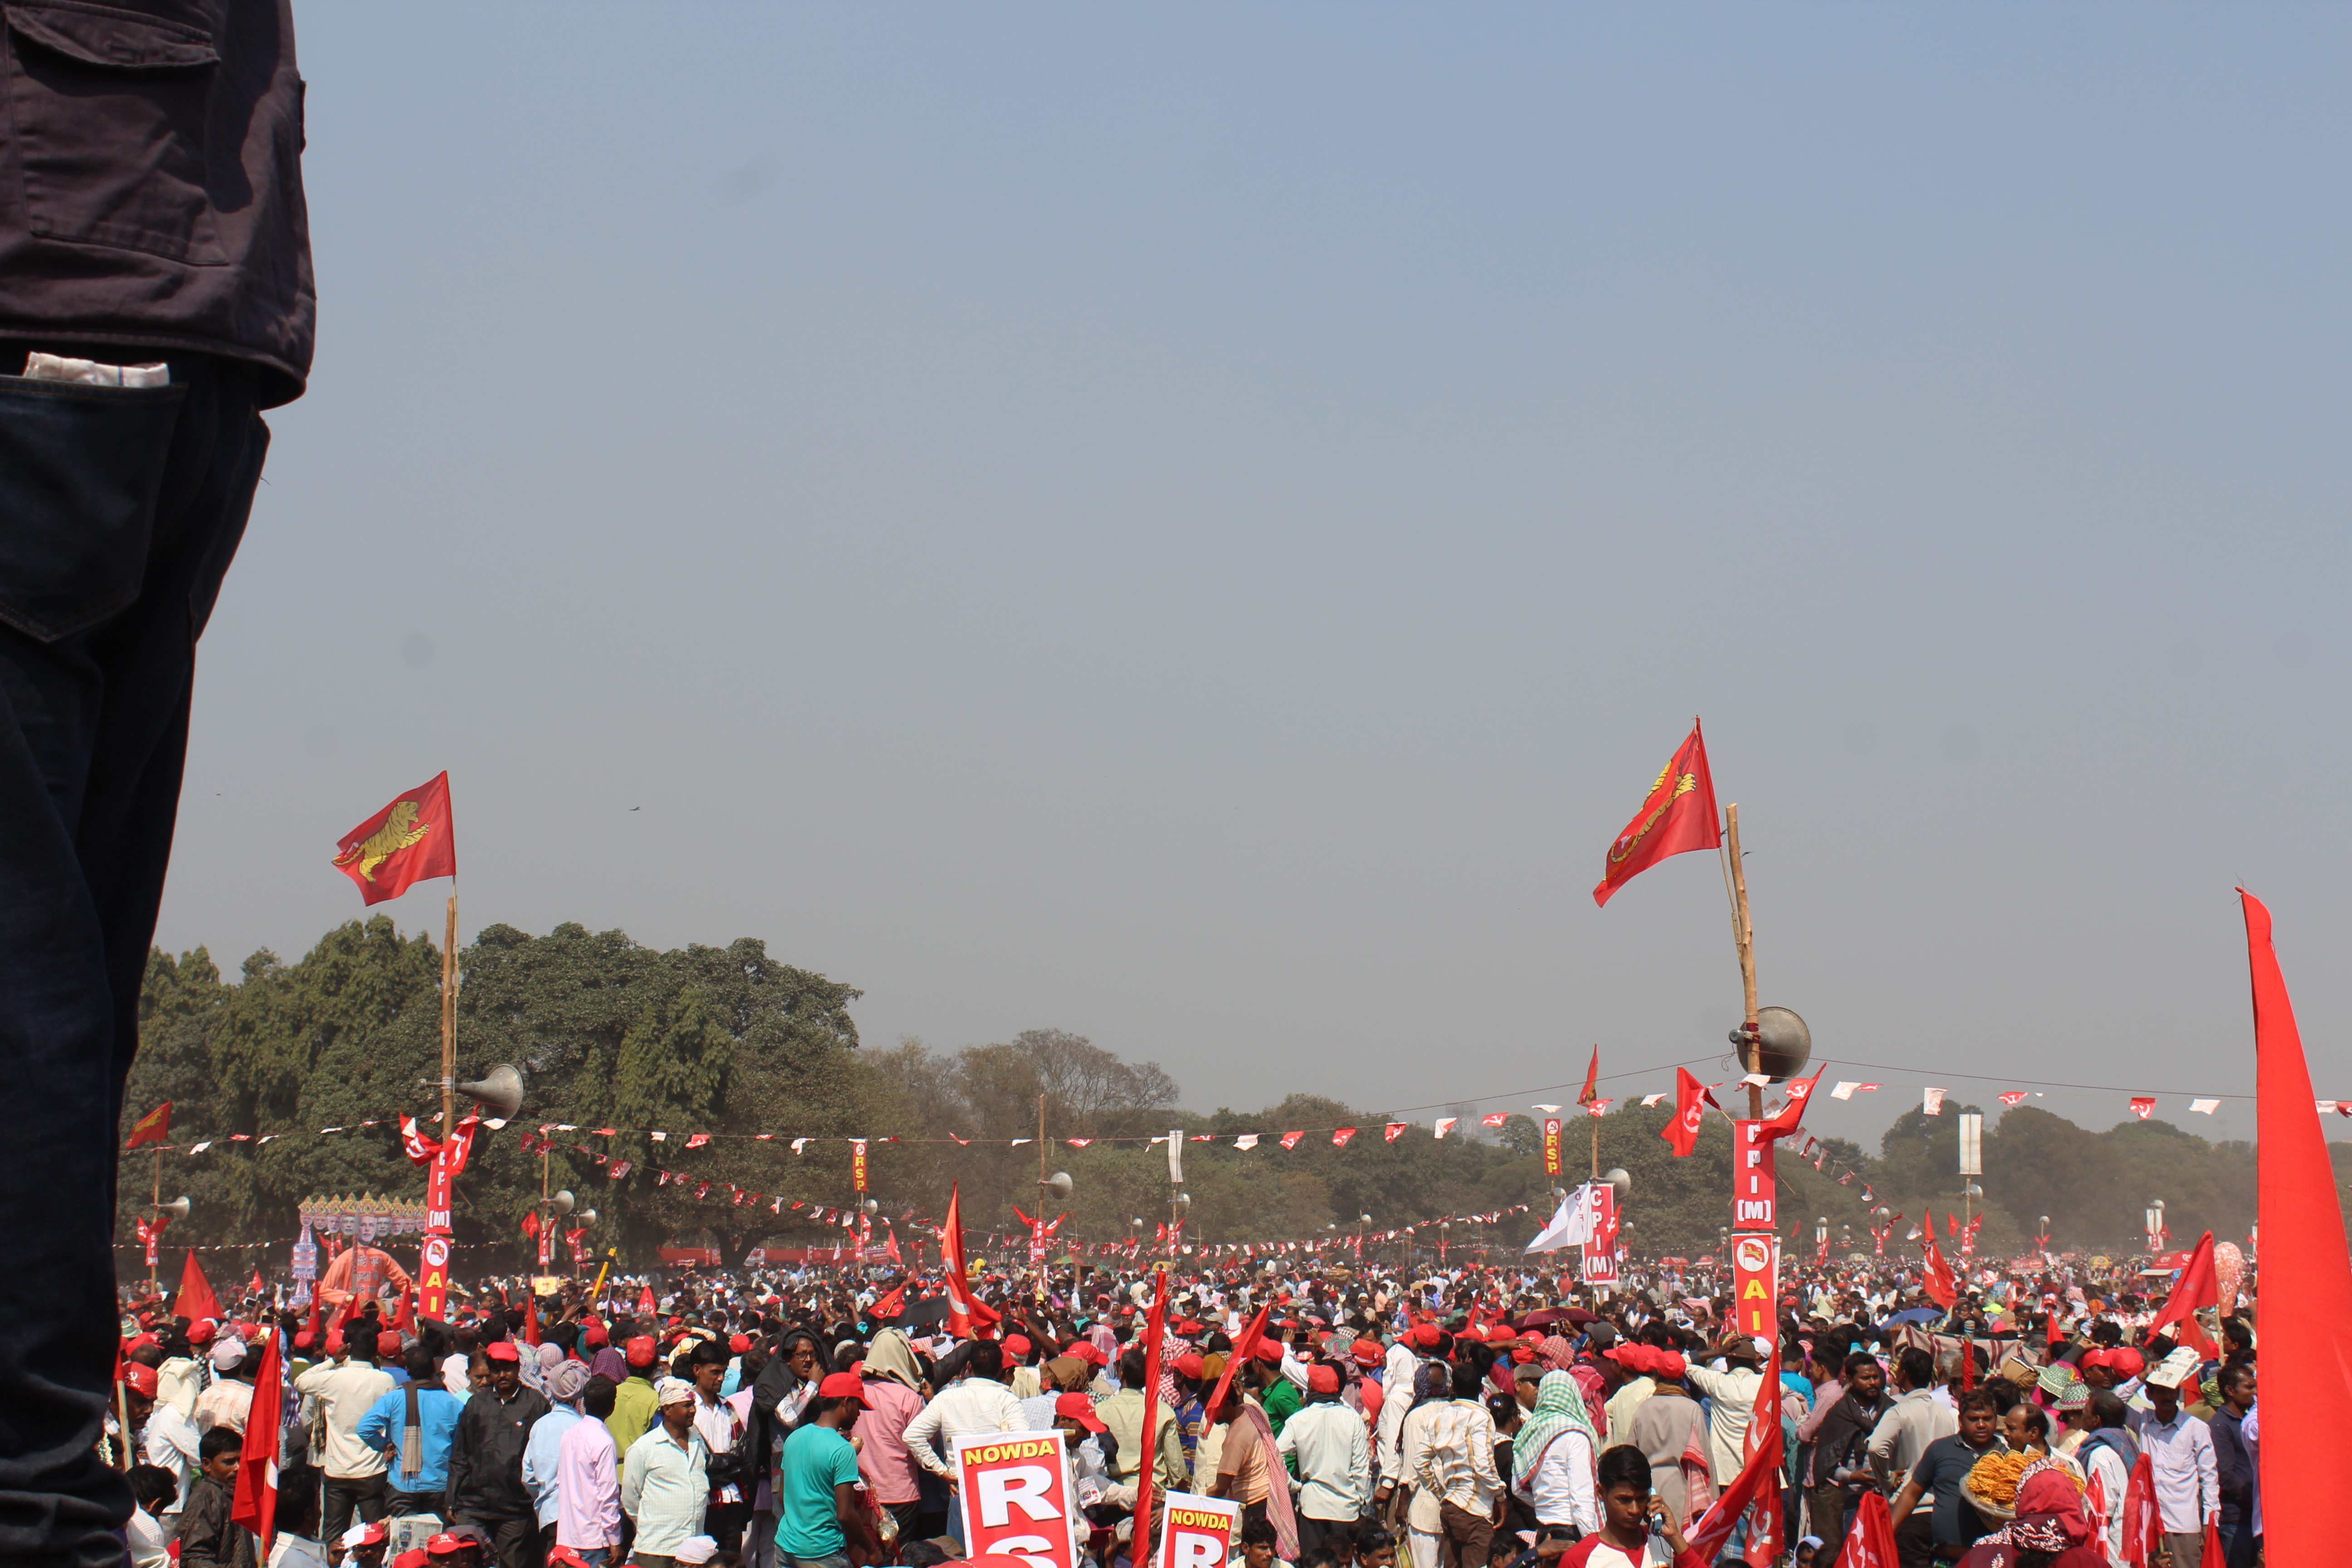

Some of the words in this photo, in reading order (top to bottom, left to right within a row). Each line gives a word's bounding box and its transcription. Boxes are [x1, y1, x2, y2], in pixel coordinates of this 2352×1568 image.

[1546, 1135, 1558, 1173] RSP
[855, 1156, 865, 1191] RSP
[965, 1440, 1055, 1466] NOWDA
[1171, 1510, 1229, 1531] NOWDA
[1174, 1531, 1223, 1568] R
